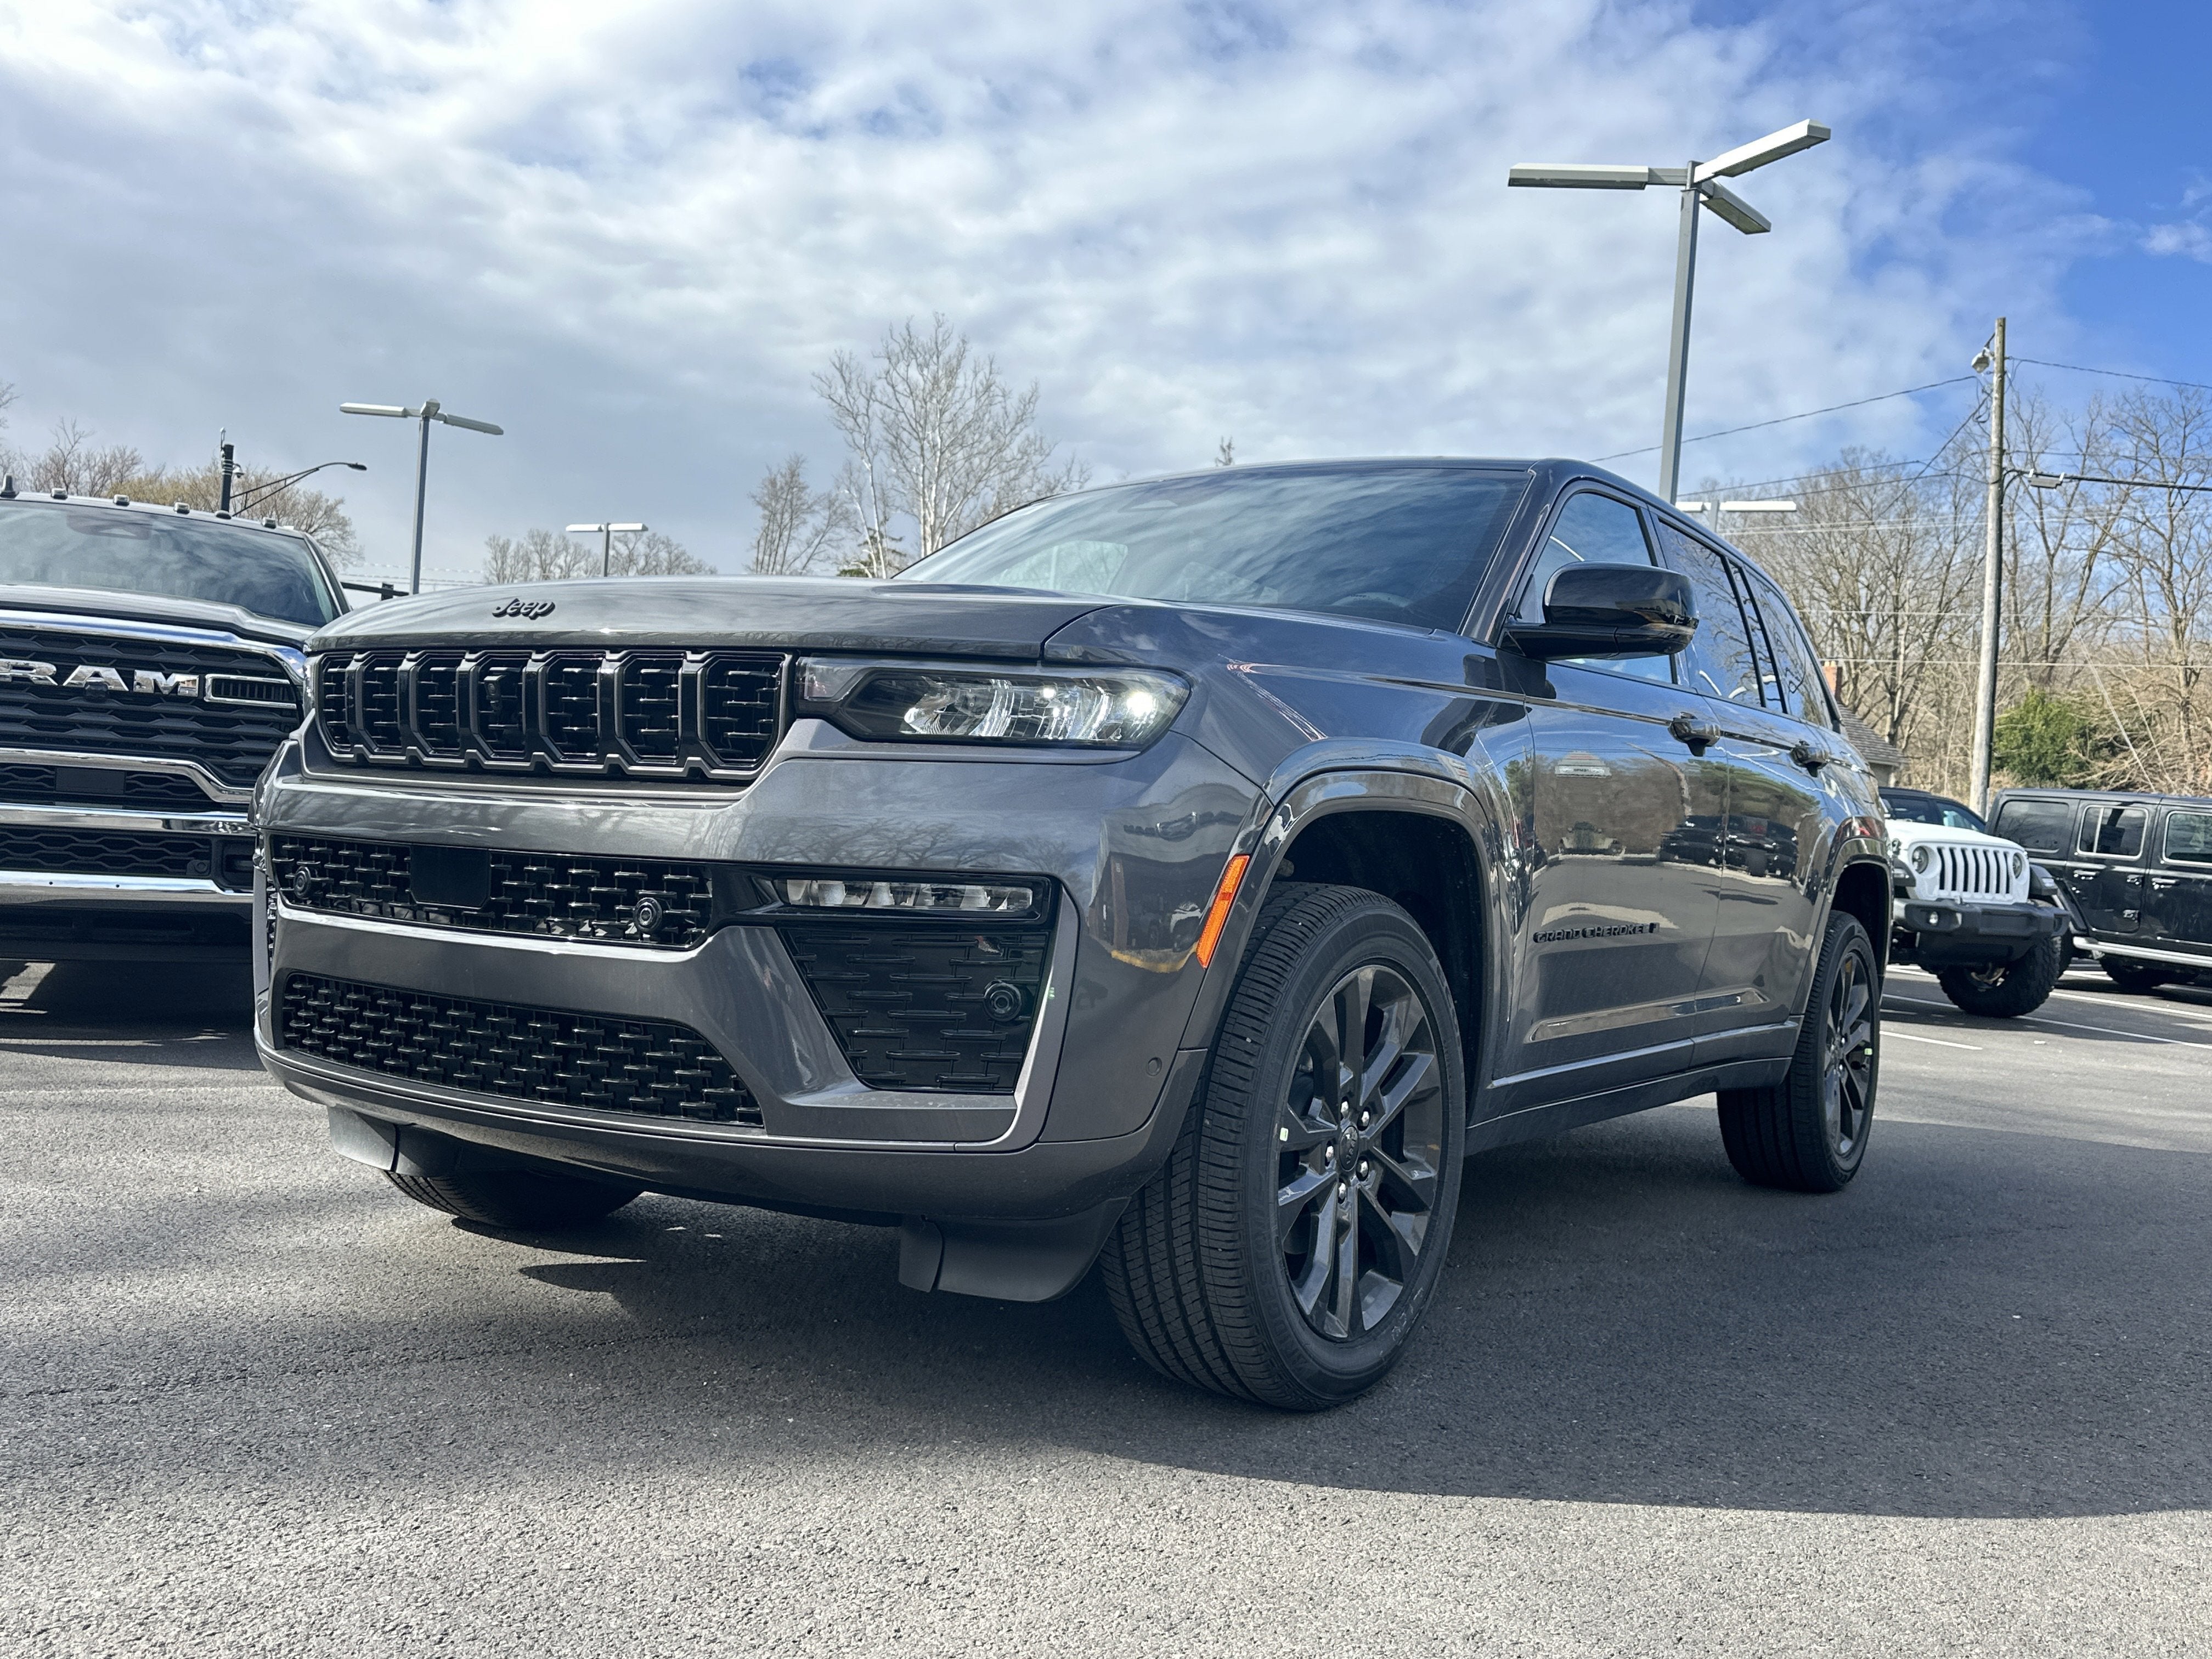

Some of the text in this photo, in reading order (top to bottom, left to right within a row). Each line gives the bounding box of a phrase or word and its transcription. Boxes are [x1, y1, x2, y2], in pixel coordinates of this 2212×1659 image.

[492, 598, 555, 620] Jeep
[0, 658, 199, 697] RAM
[1533, 924, 1649, 943] GRAND CHEROKEE
